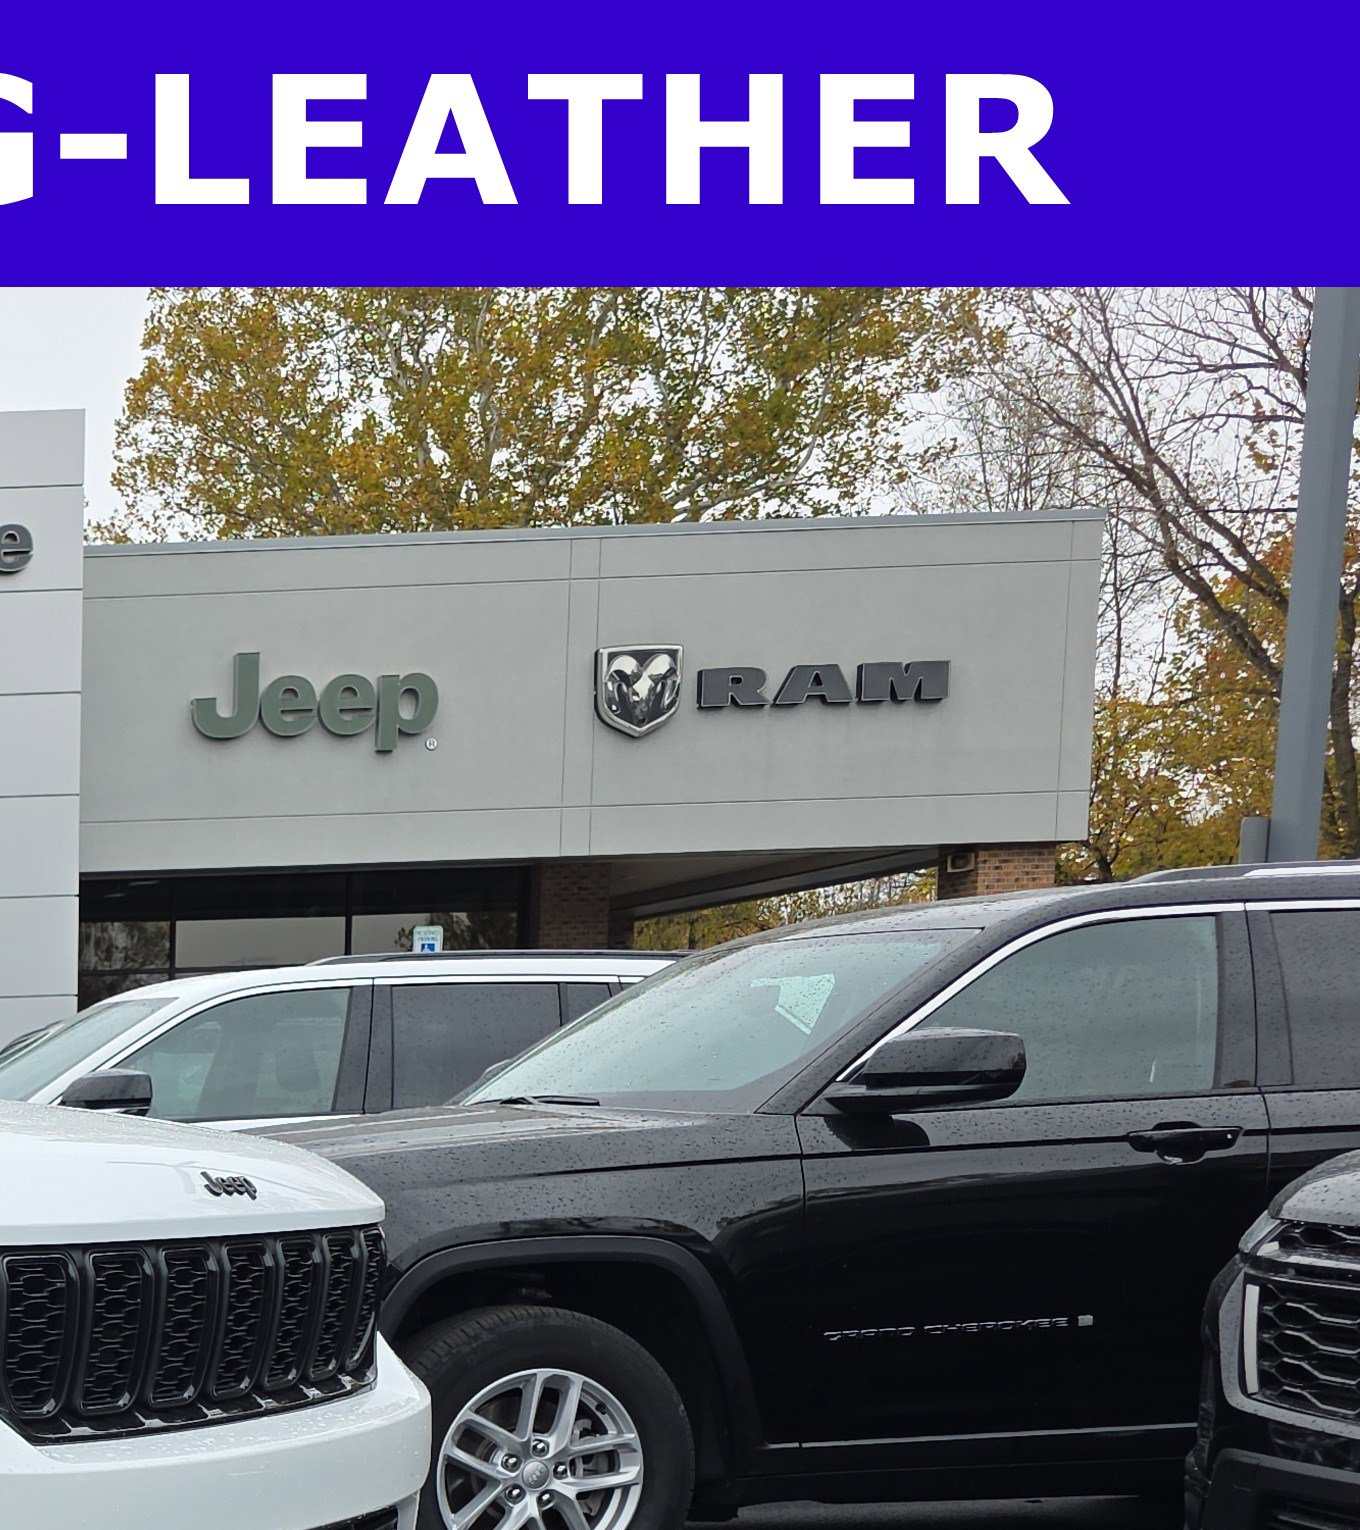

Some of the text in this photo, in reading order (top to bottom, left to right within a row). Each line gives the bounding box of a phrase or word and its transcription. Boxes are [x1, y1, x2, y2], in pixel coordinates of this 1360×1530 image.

[191, 652, 438, 753] Jeep
[697, 659, 951, 708] RAM
[200, 1171, 257, 1201] Jeep
